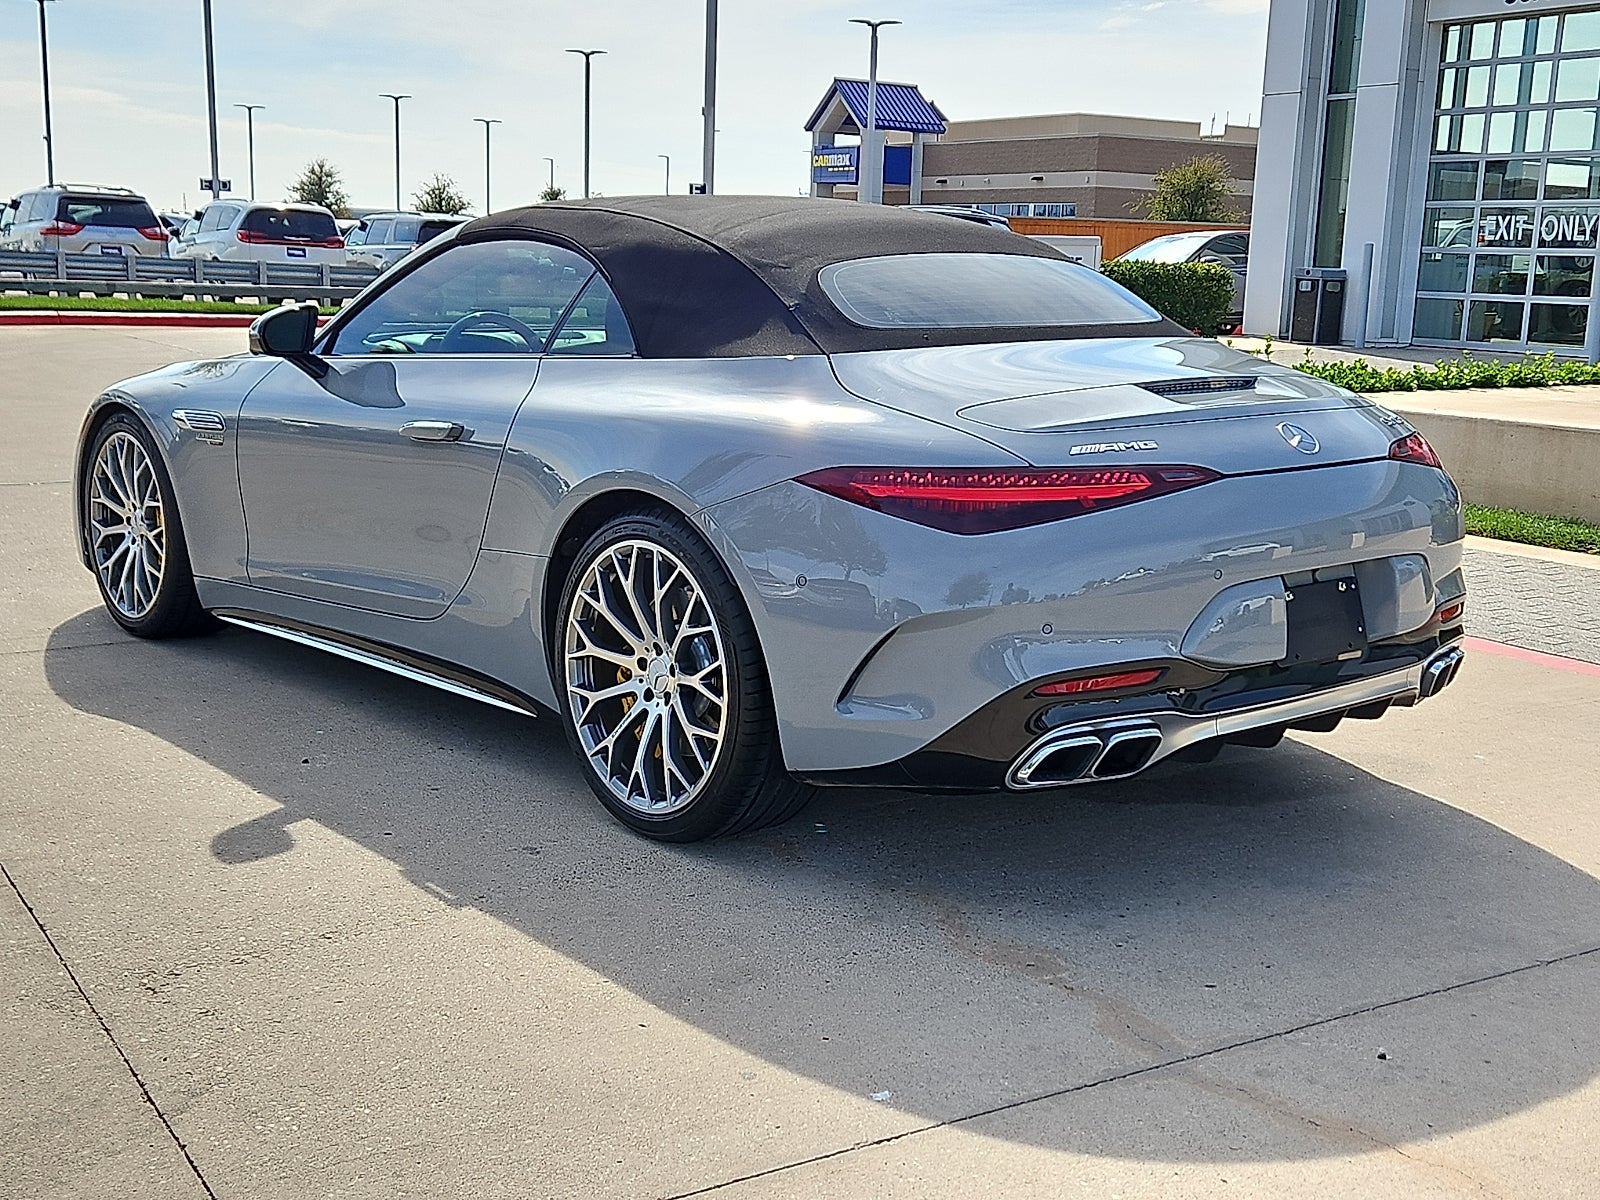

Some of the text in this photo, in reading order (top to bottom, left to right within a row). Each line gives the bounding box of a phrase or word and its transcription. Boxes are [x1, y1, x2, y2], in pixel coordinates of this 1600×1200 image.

[1485, 215, 1598, 241] EXIT ONLY
[1099, 440, 1159, 454] AMG
